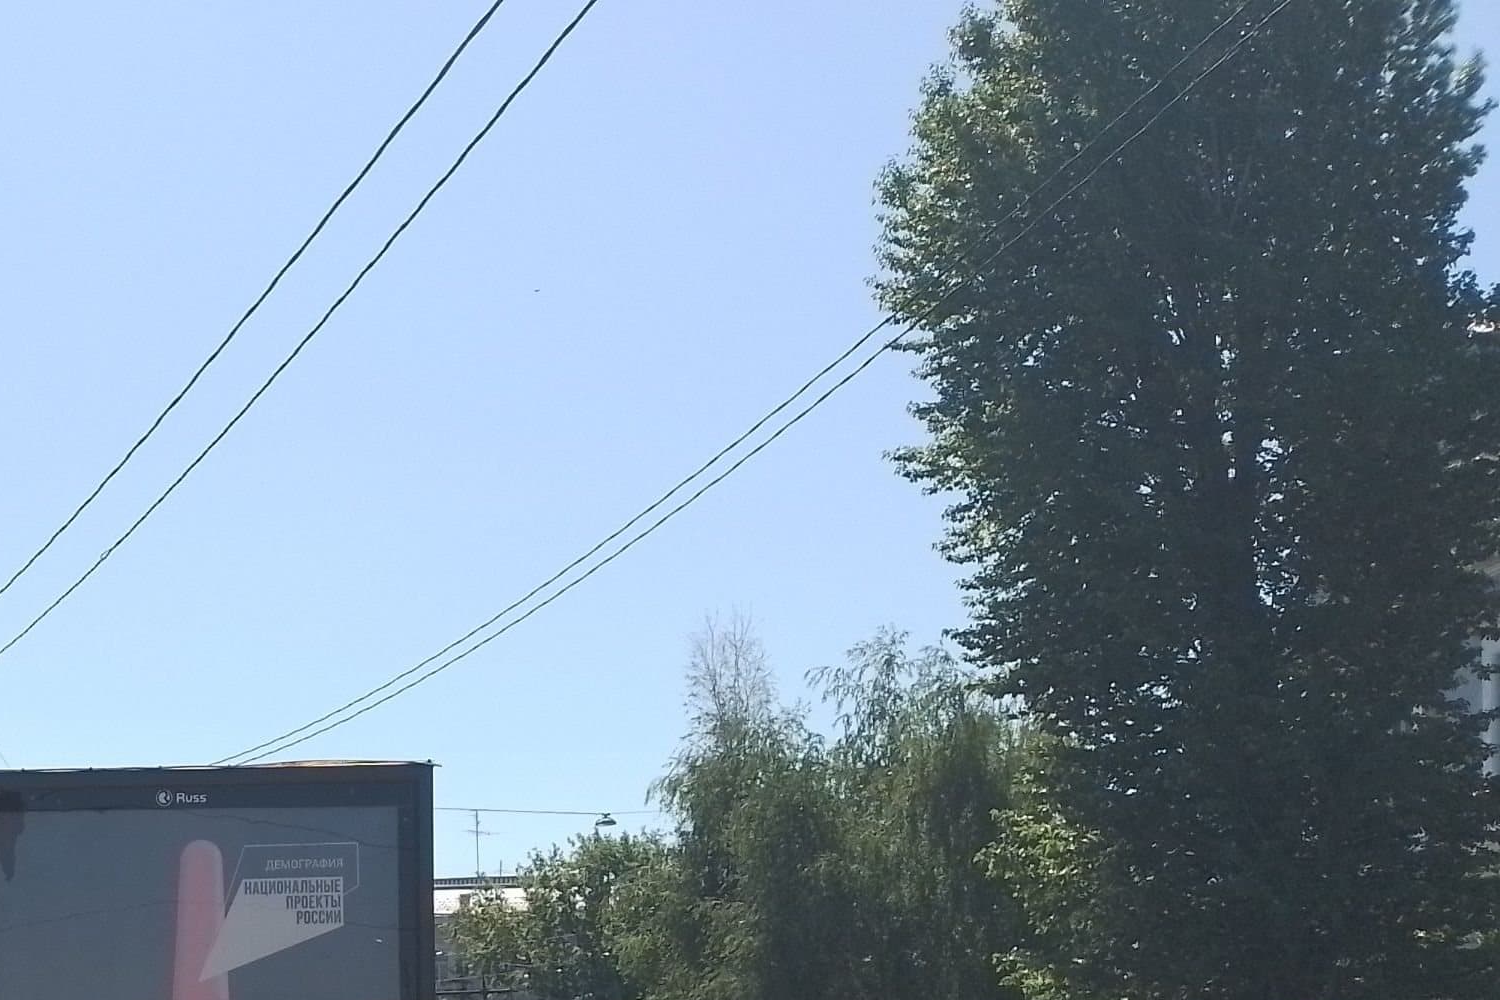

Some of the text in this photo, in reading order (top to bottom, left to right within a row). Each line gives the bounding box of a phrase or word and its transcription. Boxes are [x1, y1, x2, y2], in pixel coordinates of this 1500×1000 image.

[176, 792, 207, 804] Russ
[265, 858, 344, 872] ДЕМОГРАФИЯ
[244, 879, 341, 896] НАЦИОНАЛЬНЫЕ
[286, 894, 341, 910] ПРОЕКТЫ
[296, 909, 342, 925] РОССИИ
